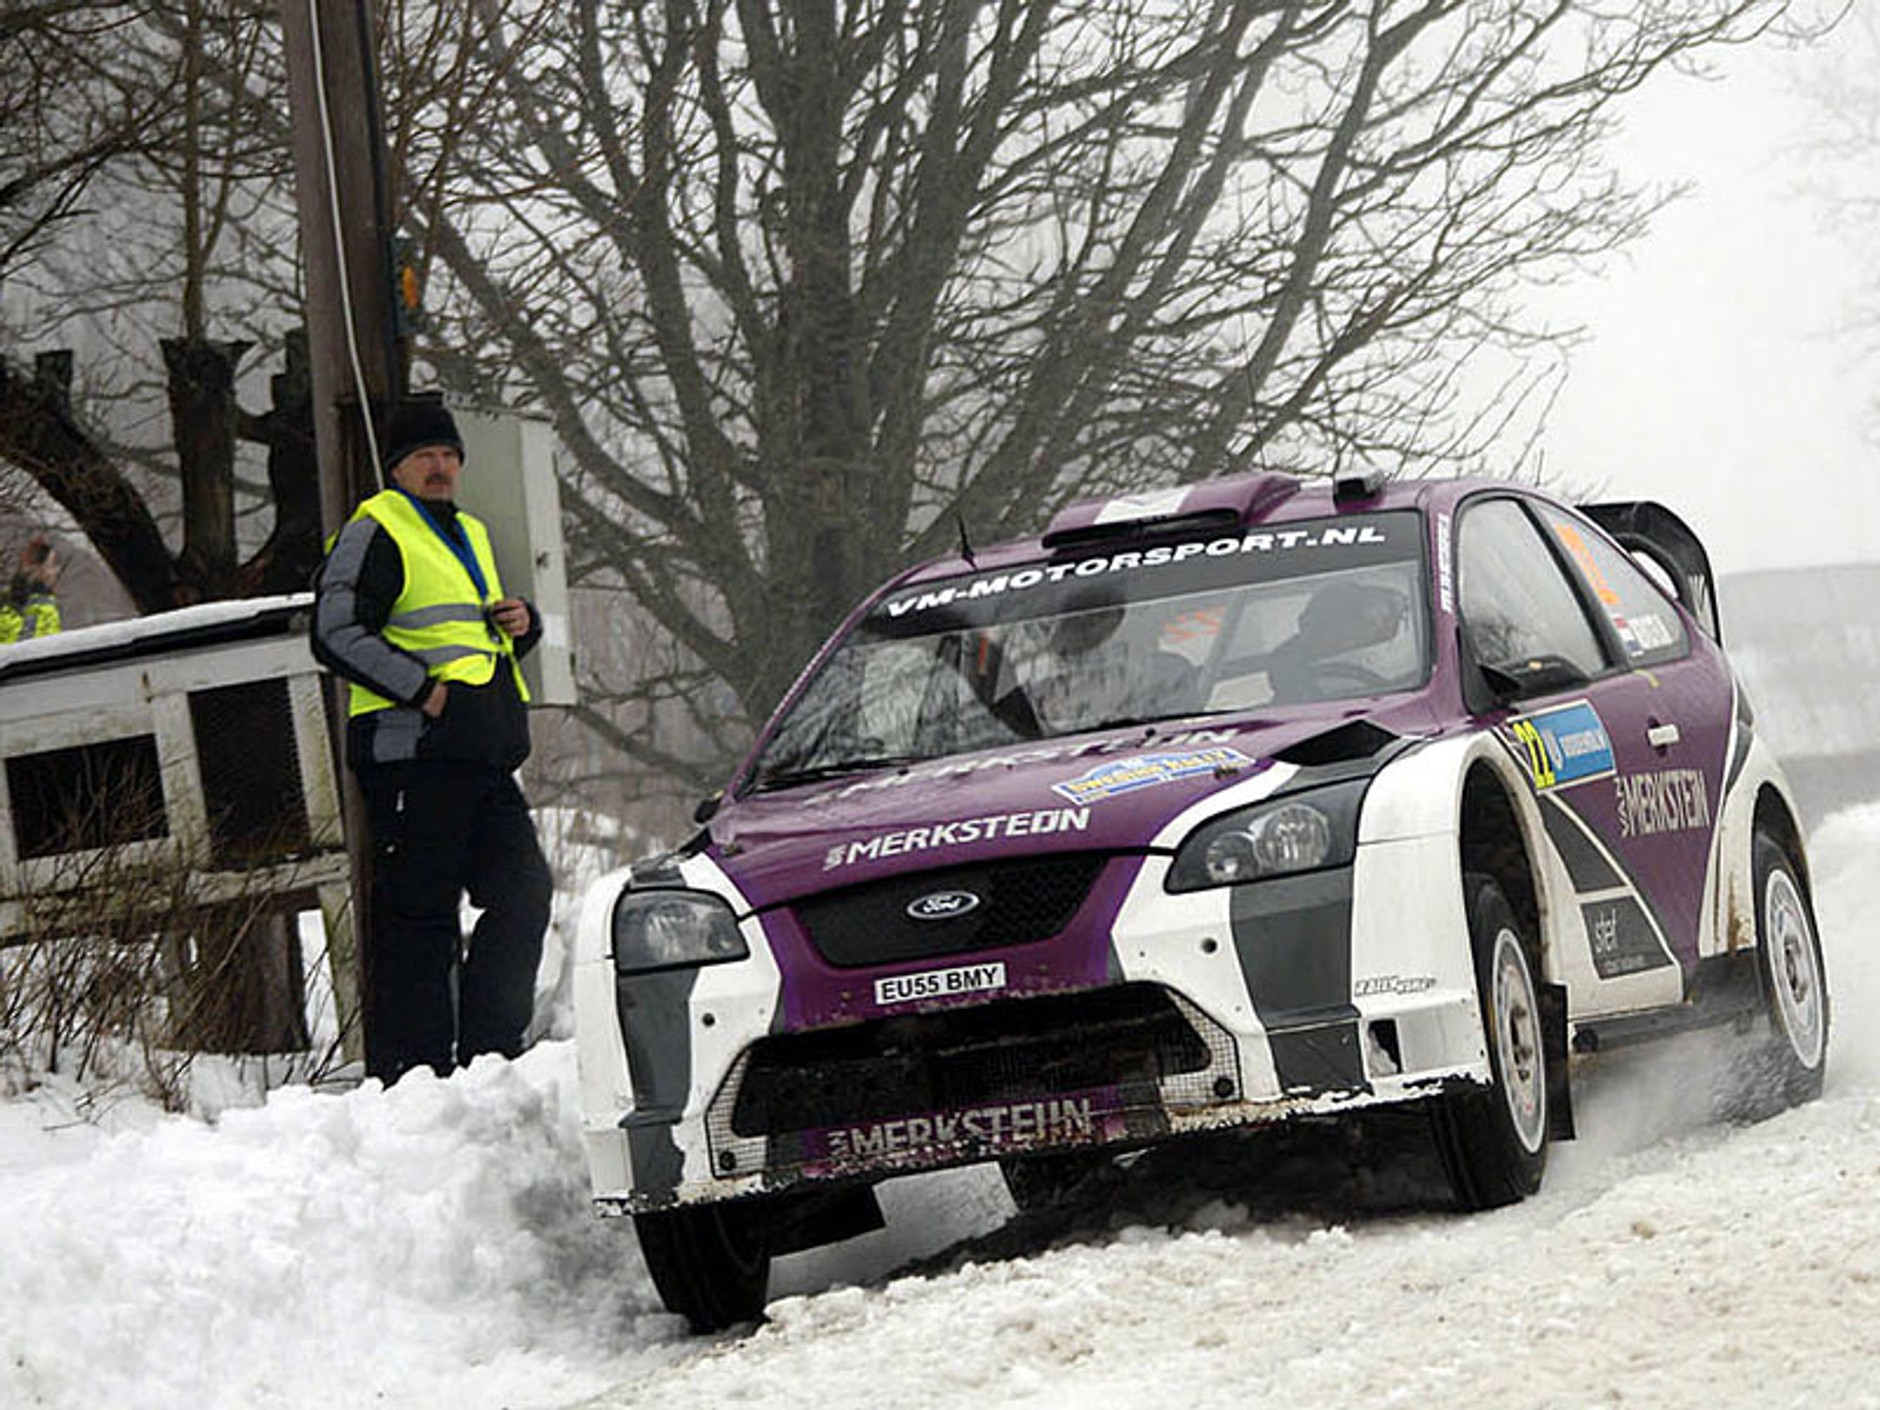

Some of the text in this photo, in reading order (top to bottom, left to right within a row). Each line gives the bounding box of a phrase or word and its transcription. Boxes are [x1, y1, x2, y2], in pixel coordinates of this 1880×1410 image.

[887, 526, 1386, 618] VM-MOTORSPORT.NL
[1513, 720, 1555, 788] 22
[881, 966, 998, 1000] EU55 BMY
